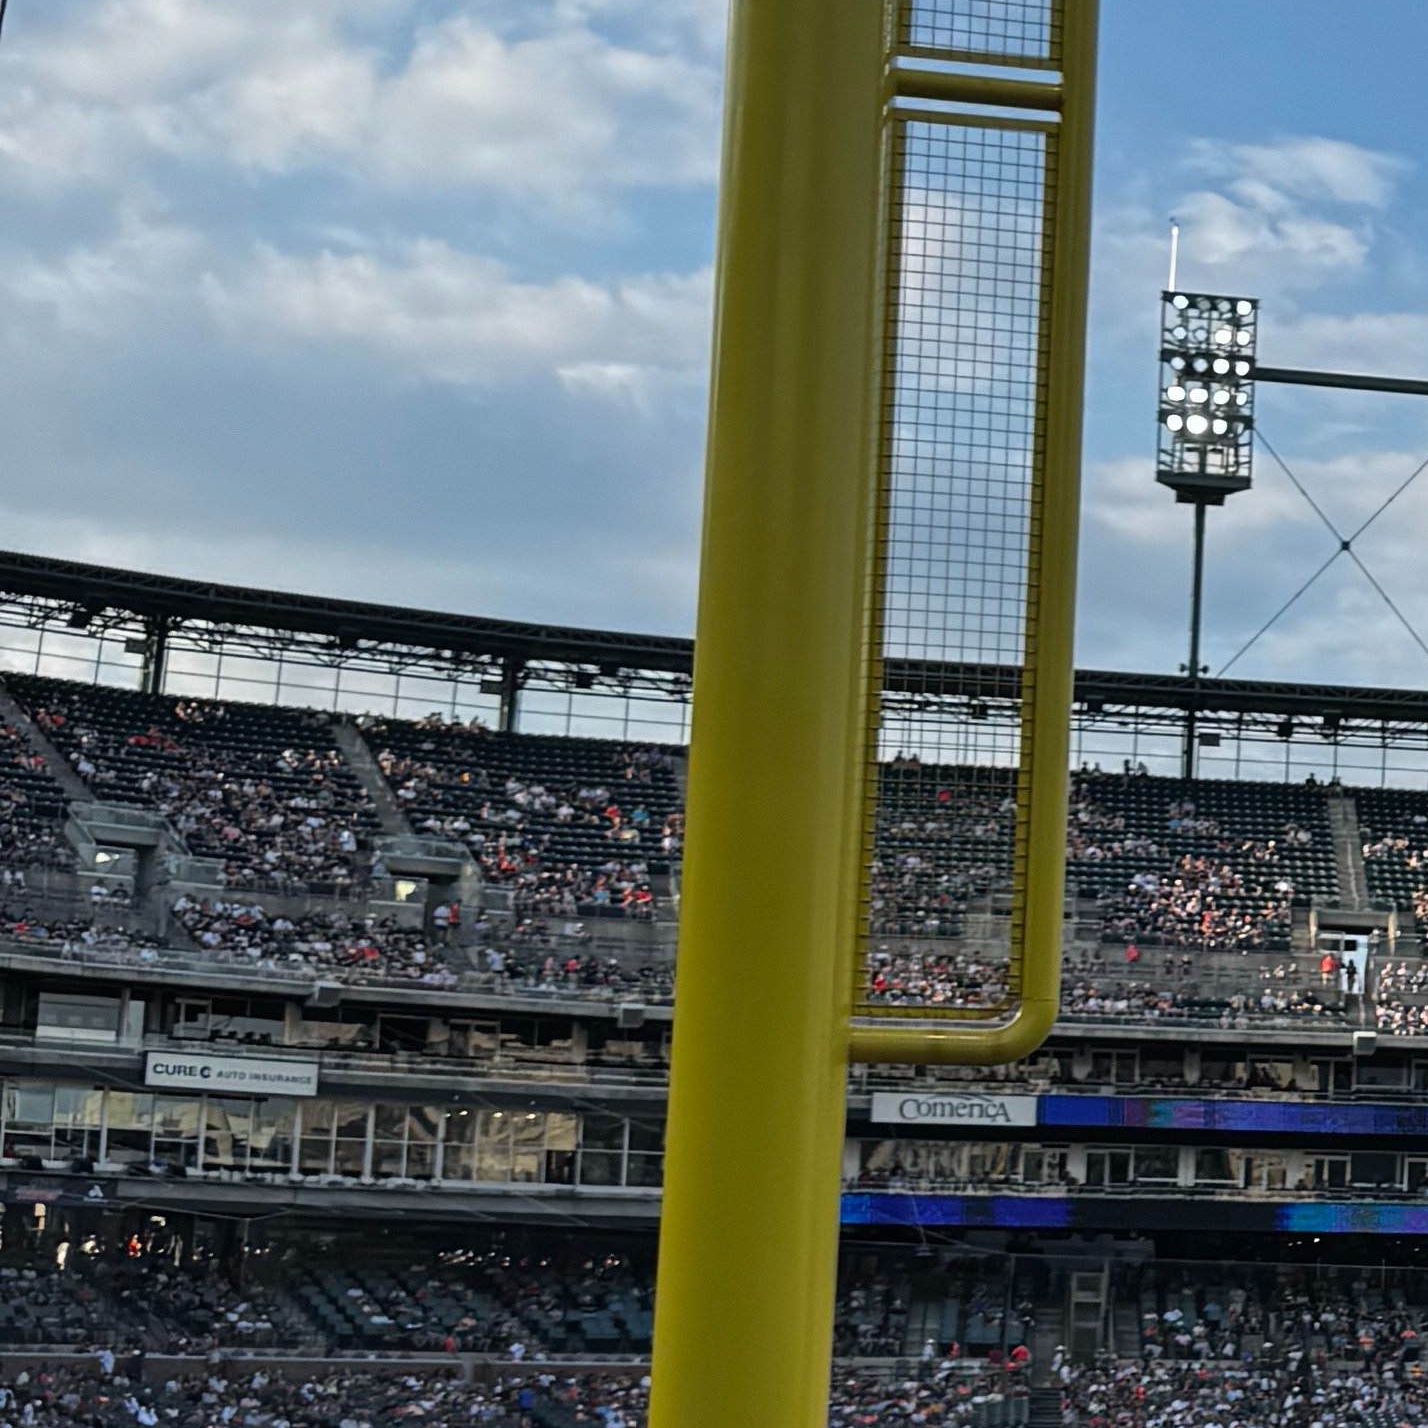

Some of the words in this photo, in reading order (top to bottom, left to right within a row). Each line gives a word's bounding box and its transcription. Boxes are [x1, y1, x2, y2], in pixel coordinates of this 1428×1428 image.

[153, 1063, 198, 1077] CURE
[217, 1071, 245, 1080] AUTO
[249, 1073, 312, 1084] INSURANCE
